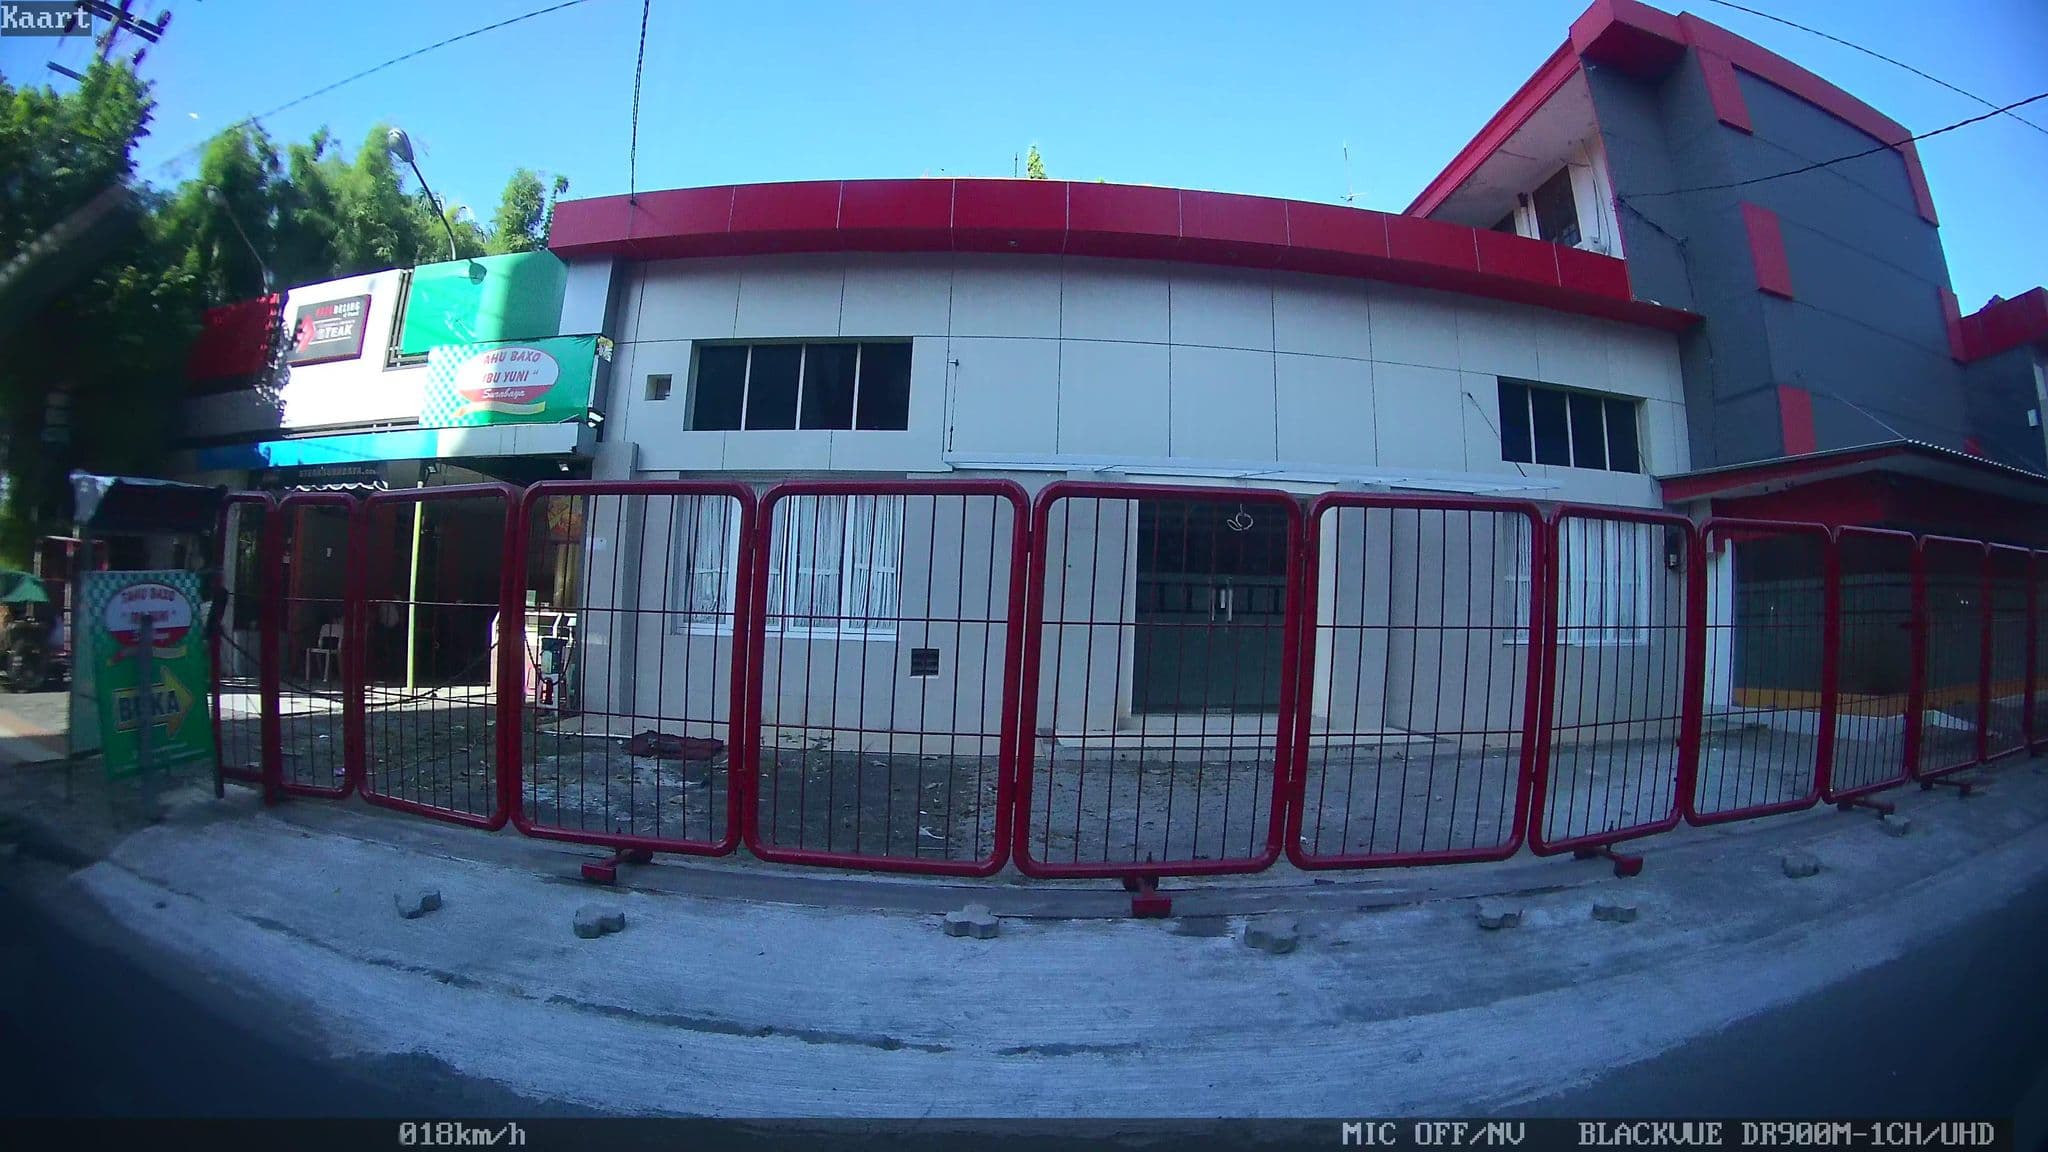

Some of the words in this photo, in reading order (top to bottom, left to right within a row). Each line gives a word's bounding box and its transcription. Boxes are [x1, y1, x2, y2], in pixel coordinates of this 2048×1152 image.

[317, 324, 354, 340] STEAK
[483, 352, 506, 365] AHU
[510, 350, 542, 363] BAXO
[504, 370, 530, 383] YUNI
[481, 386, 526, 400] Surabaya
